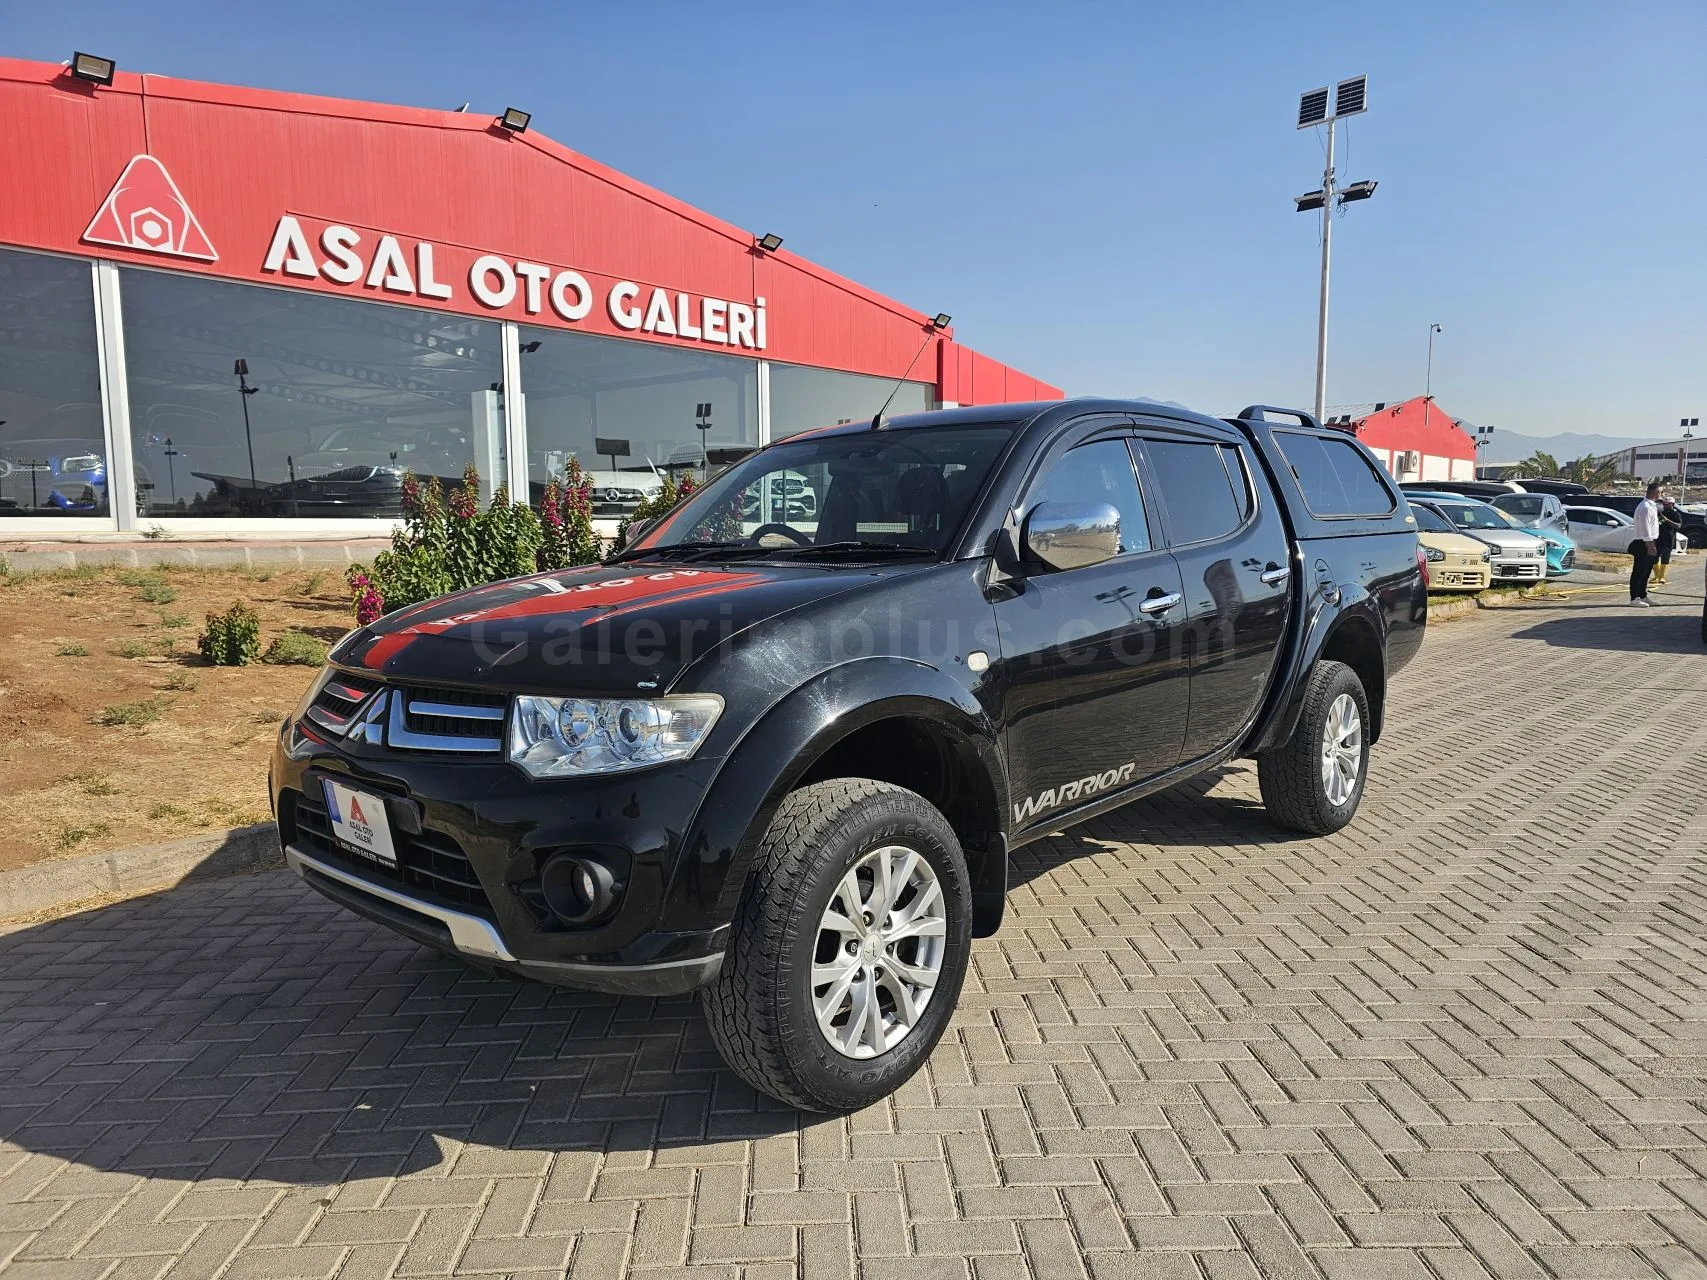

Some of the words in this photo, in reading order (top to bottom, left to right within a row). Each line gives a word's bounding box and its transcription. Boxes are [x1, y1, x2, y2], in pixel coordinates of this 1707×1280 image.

[262, 215, 453, 300] ASAL
[470, 255, 593, 321] OTO
[608, 281, 767, 350] GALERİ
[1013, 762, 1136, 823] WARRIOR
